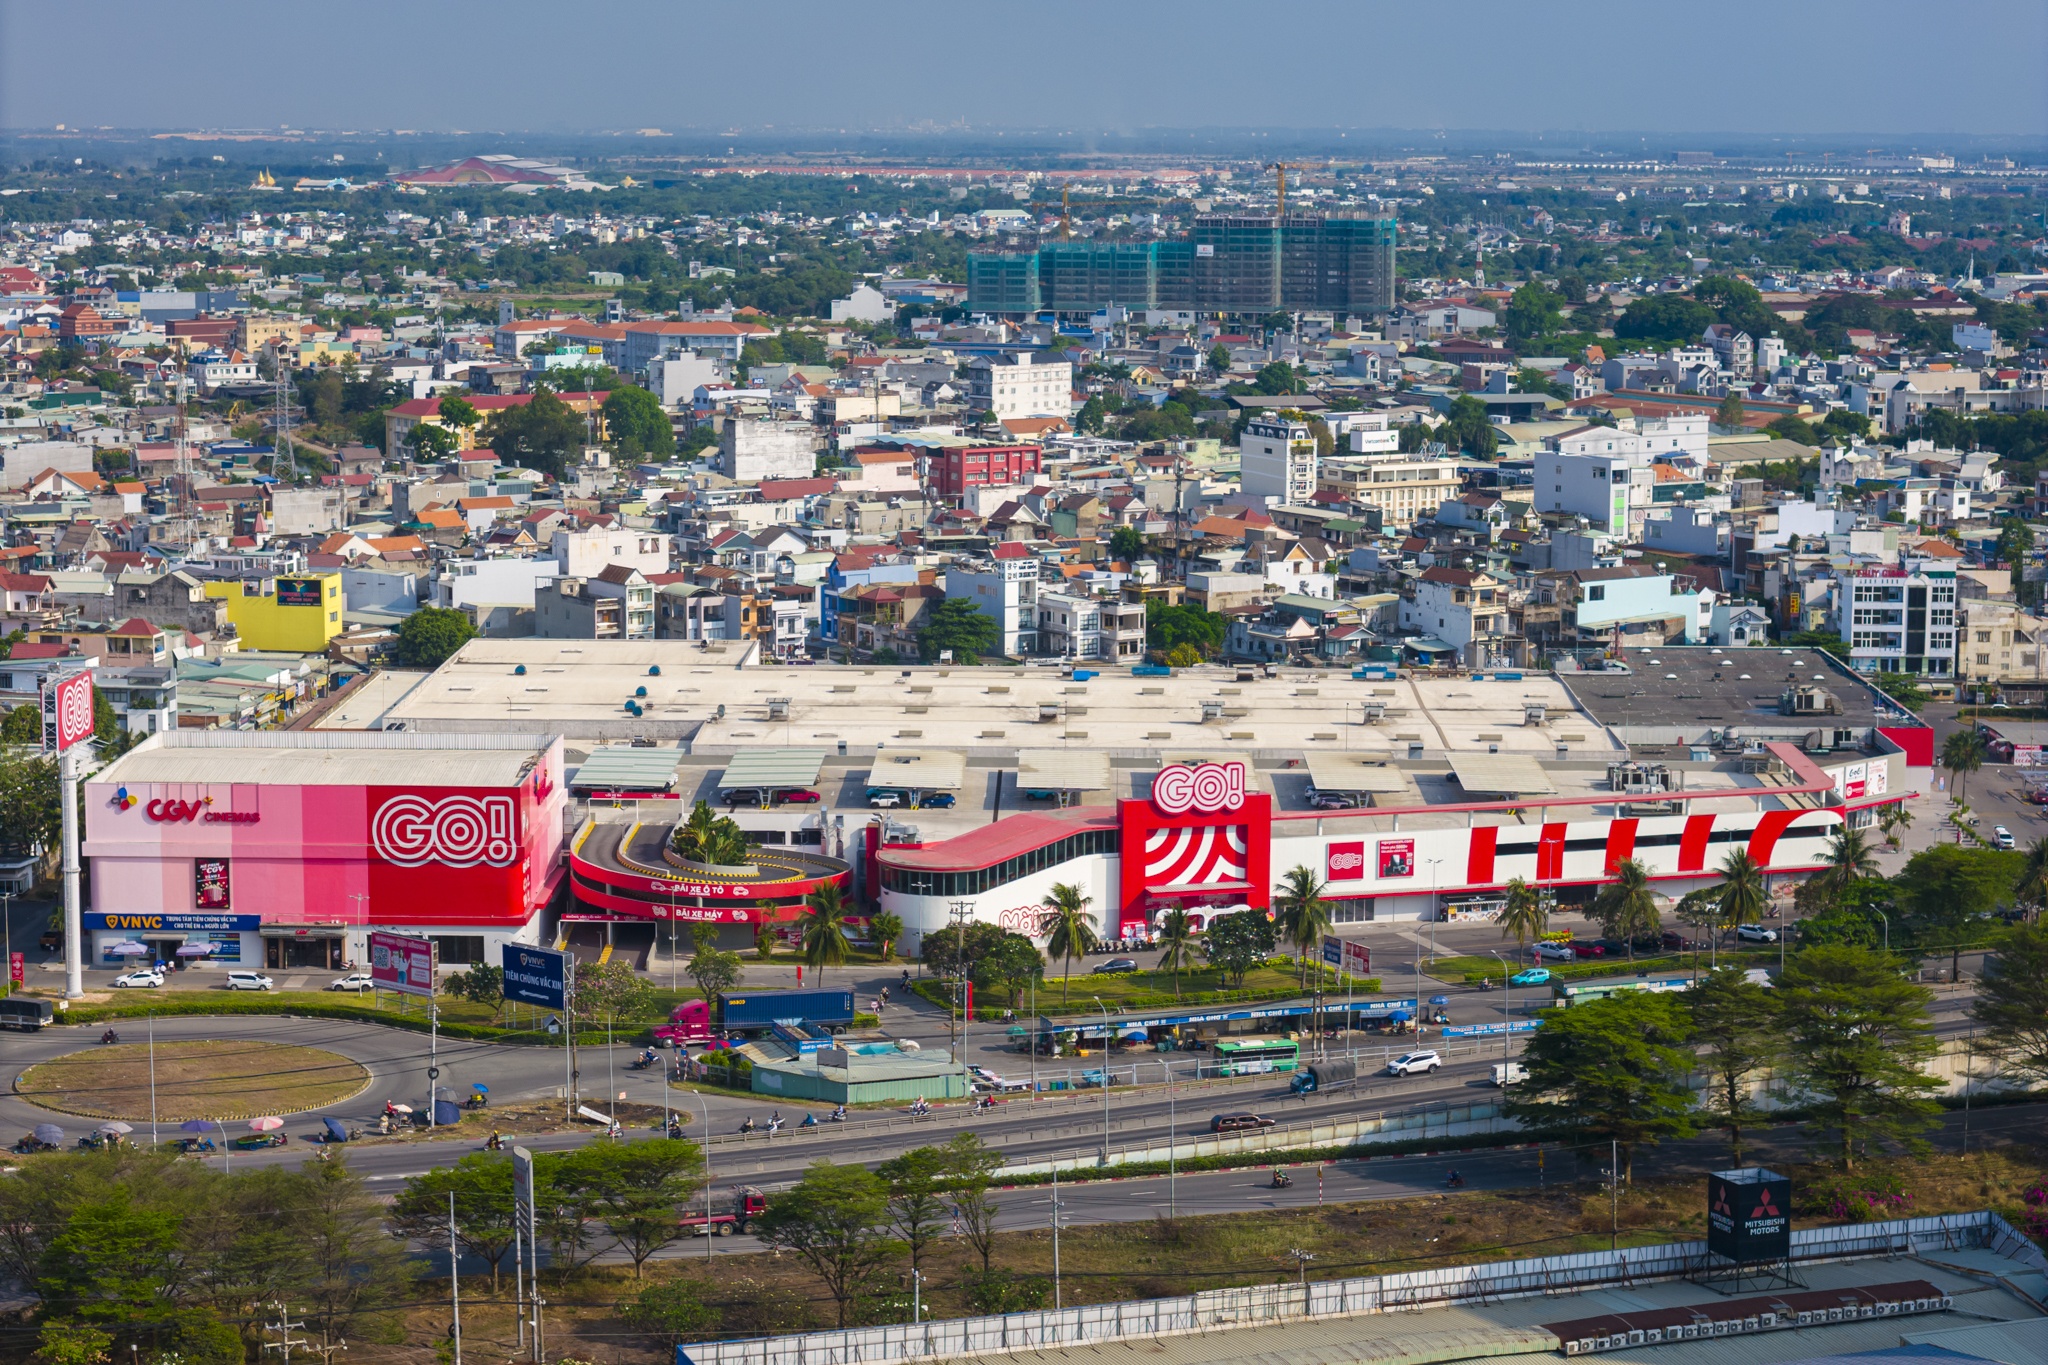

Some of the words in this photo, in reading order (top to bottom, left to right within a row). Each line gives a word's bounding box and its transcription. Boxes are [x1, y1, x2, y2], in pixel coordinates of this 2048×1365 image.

[62, 676, 91, 741] GO!
[1153, 762, 1245, 814] GO!
[147, 799, 202, 821] CGV
[204, 812, 260, 823] CINEMAS
[372, 795, 517, 868] GO!
[675, 883, 689, 892] BÃI
[703, 884, 710, 893] Ô
[712, 885, 724, 894] TÔ
[676, 907, 690, 917] BÃI
[691, 910, 703, 918] XE
[704, 909, 723, 918] MÁY
[120, 915, 163, 929] VNVC
[527, 956, 546, 966] VNVC
[505, 970, 519, 982] TIÊM
[552, 980, 562, 990] XIN
[1710, 1211, 1735, 1228] MITSUBISHI
[1745, 1217, 1785, 1229] MITSUBISHI
[1713, 1220, 1732, 1234] MOTORS
[1750, 1225, 1780, 1236] MOTORS
